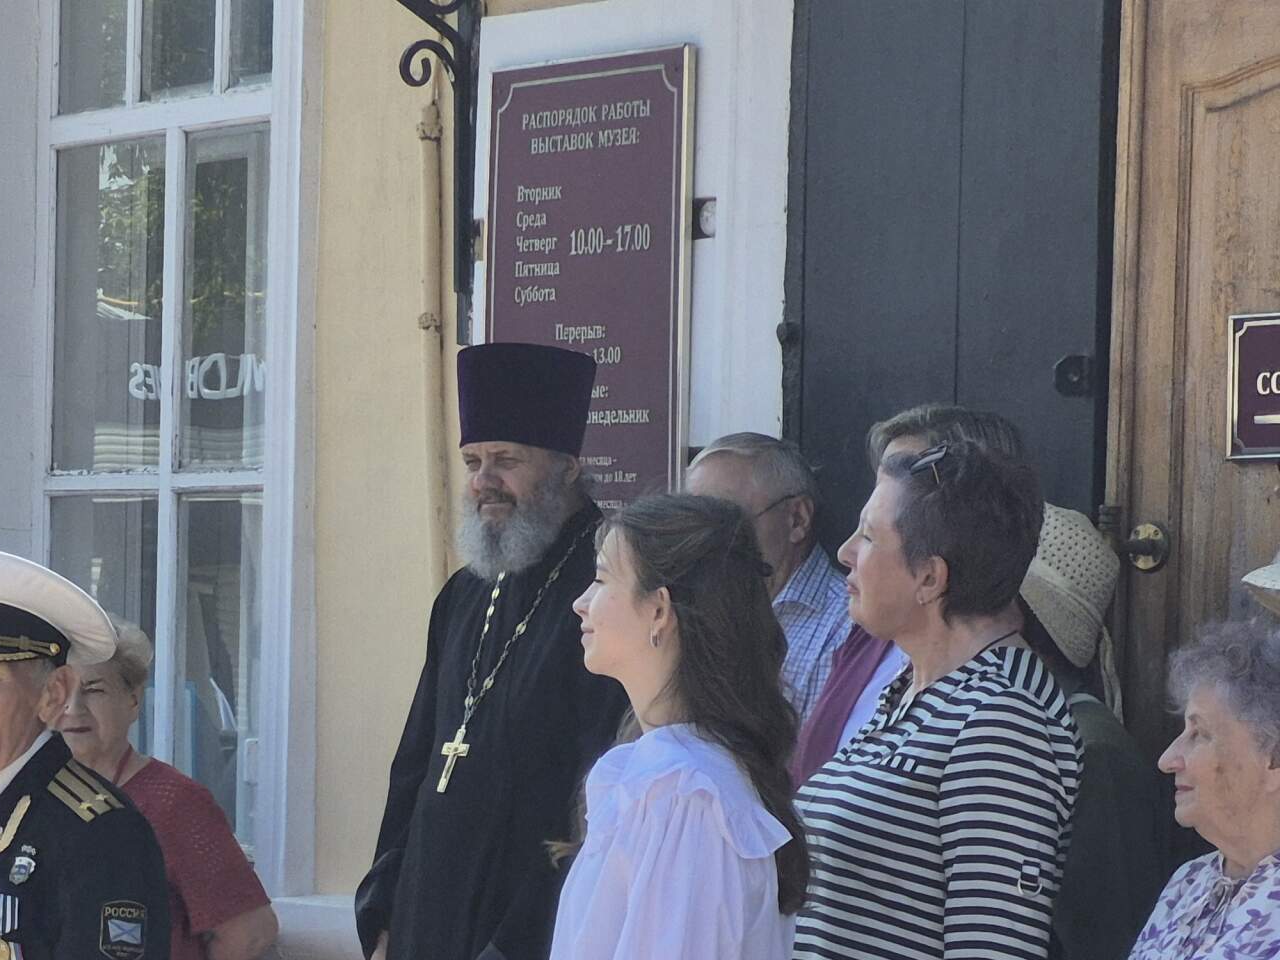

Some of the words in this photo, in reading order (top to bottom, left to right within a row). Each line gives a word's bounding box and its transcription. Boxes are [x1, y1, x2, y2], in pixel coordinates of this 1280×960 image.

[522, 105, 597, 130] РАСПОРЯДОК
[602, 99, 650, 121] РАБОТЫ
[531, 132, 594, 154] ВЫСТАВОК
[598, 127, 640, 148] МУЗЕЯ:
[517, 185, 562, 205] Вторник
[516, 211, 547, 231] Среда
[516, 236, 558, 254] Четверг
[515, 261, 560, 277] Пятница
[515, 285, 556, 306] Суббота
[555, 323, 606, 344] Перерыв:
[586, 409, 650, 427] недельник
